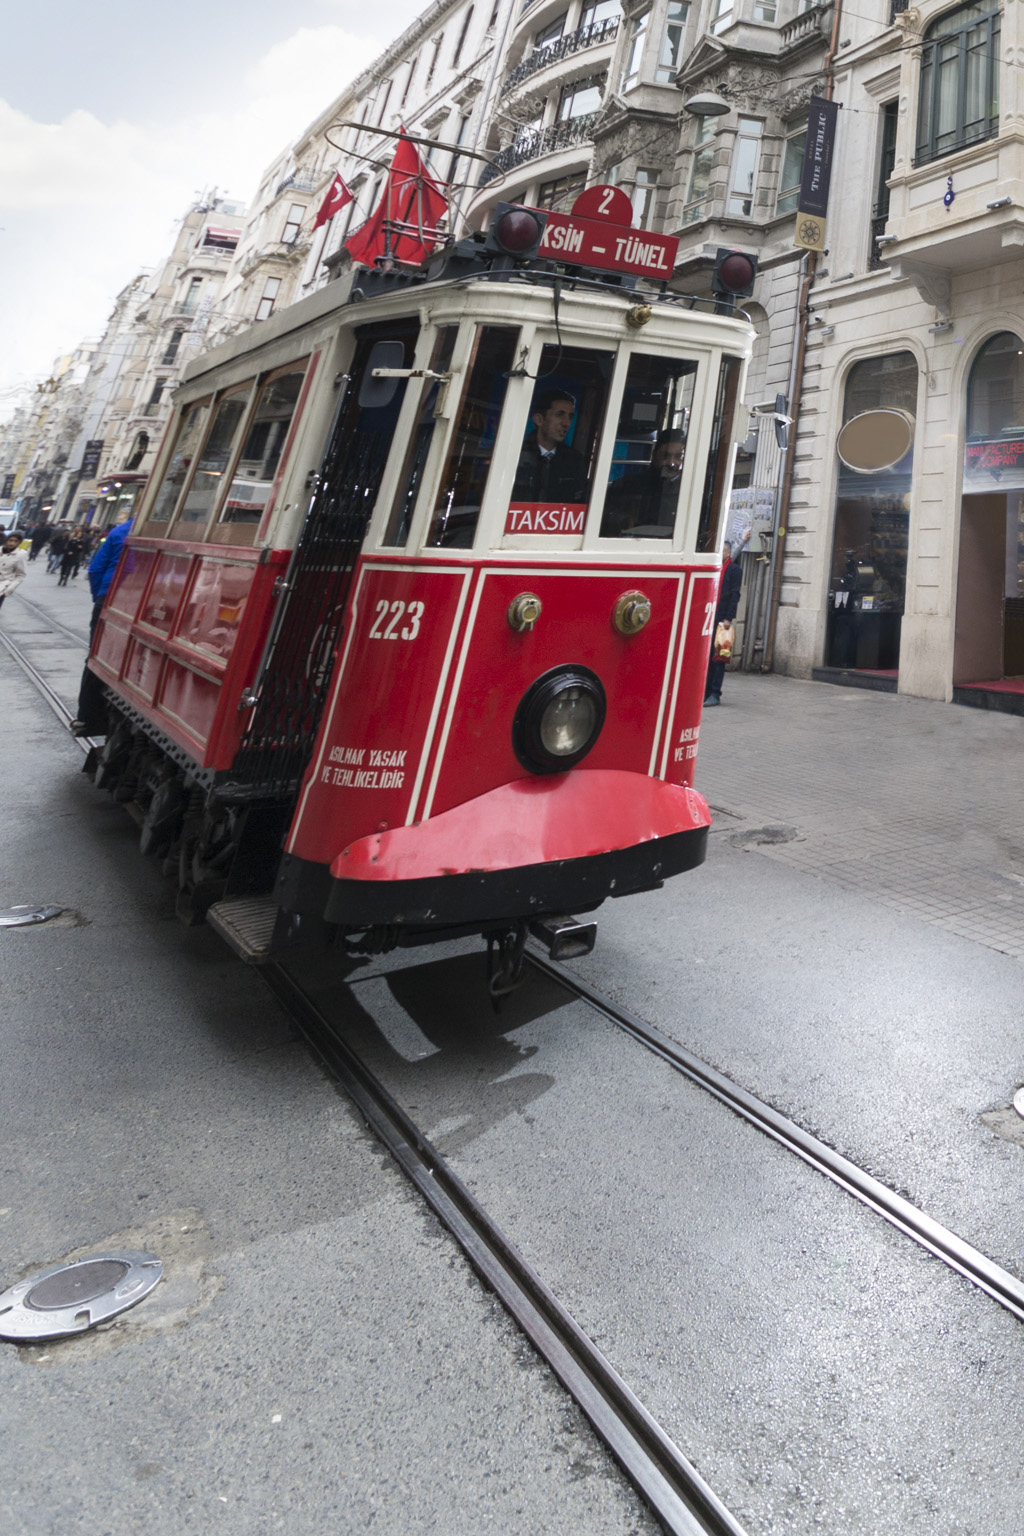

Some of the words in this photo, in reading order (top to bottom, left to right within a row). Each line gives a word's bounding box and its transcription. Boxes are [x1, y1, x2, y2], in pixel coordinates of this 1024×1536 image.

[814, 112, 826, 162] PUBLIC
[811, 165, 821, 192] THE
[597, 188, 615, 215] 2
[539, 223, 585, 253] KSİM
[614, 236, 669, 270] TÜNEL
[981, 454, 1018, 468] COMPANY
[508, 507, 585, 531] TAKSİM
[368, 599, 425, 641] 223
[328, 745, 366, 765] ASILMAK
[368, 750, 408, 767] YASAK
[674, 747, 685, 762] VE
[320, 765, 332, 783] VE
[332, 767, 405, 789] TEHLİKELİDİR
